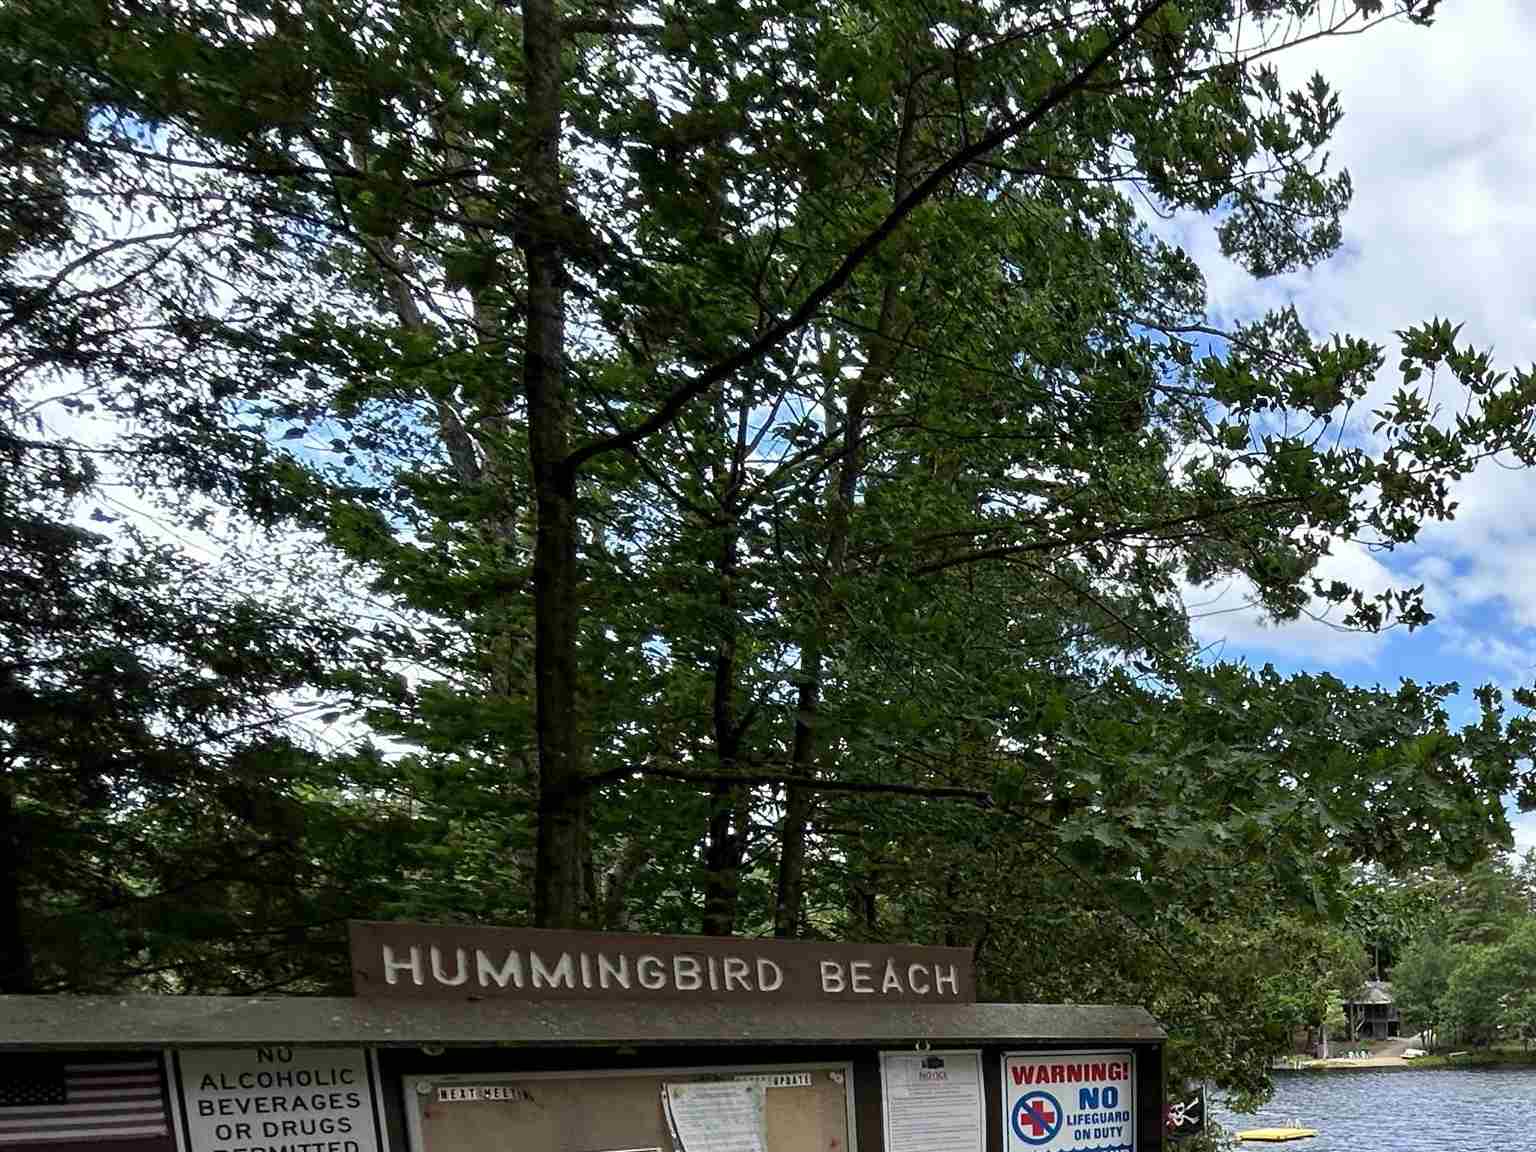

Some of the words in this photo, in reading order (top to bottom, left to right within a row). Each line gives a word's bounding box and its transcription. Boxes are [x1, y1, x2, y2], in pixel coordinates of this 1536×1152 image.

[382, 944, 785, 992] HUMMINGBIRD
[820, 959, 960, 995] BEACH
[257, 1047, 293, 1063] NO
[200, 1068, 356, 1091] ALCOHOLIC
[1012, 1062, 1129, 1085] WARNING!
[198, 1092, 361, 1116] BEVERAGES
[1079, 1086, 1118, 1110] NO
[215, 1122, 252, 1141] OR
[263, 1117, 352, 1138] DRUGS
[1067, 1111, 1129, 1126] LIFEGUARD
[1074, 1130, 1090, 1141] ON
[1093, 1126, 1123, 1139] DUTY
